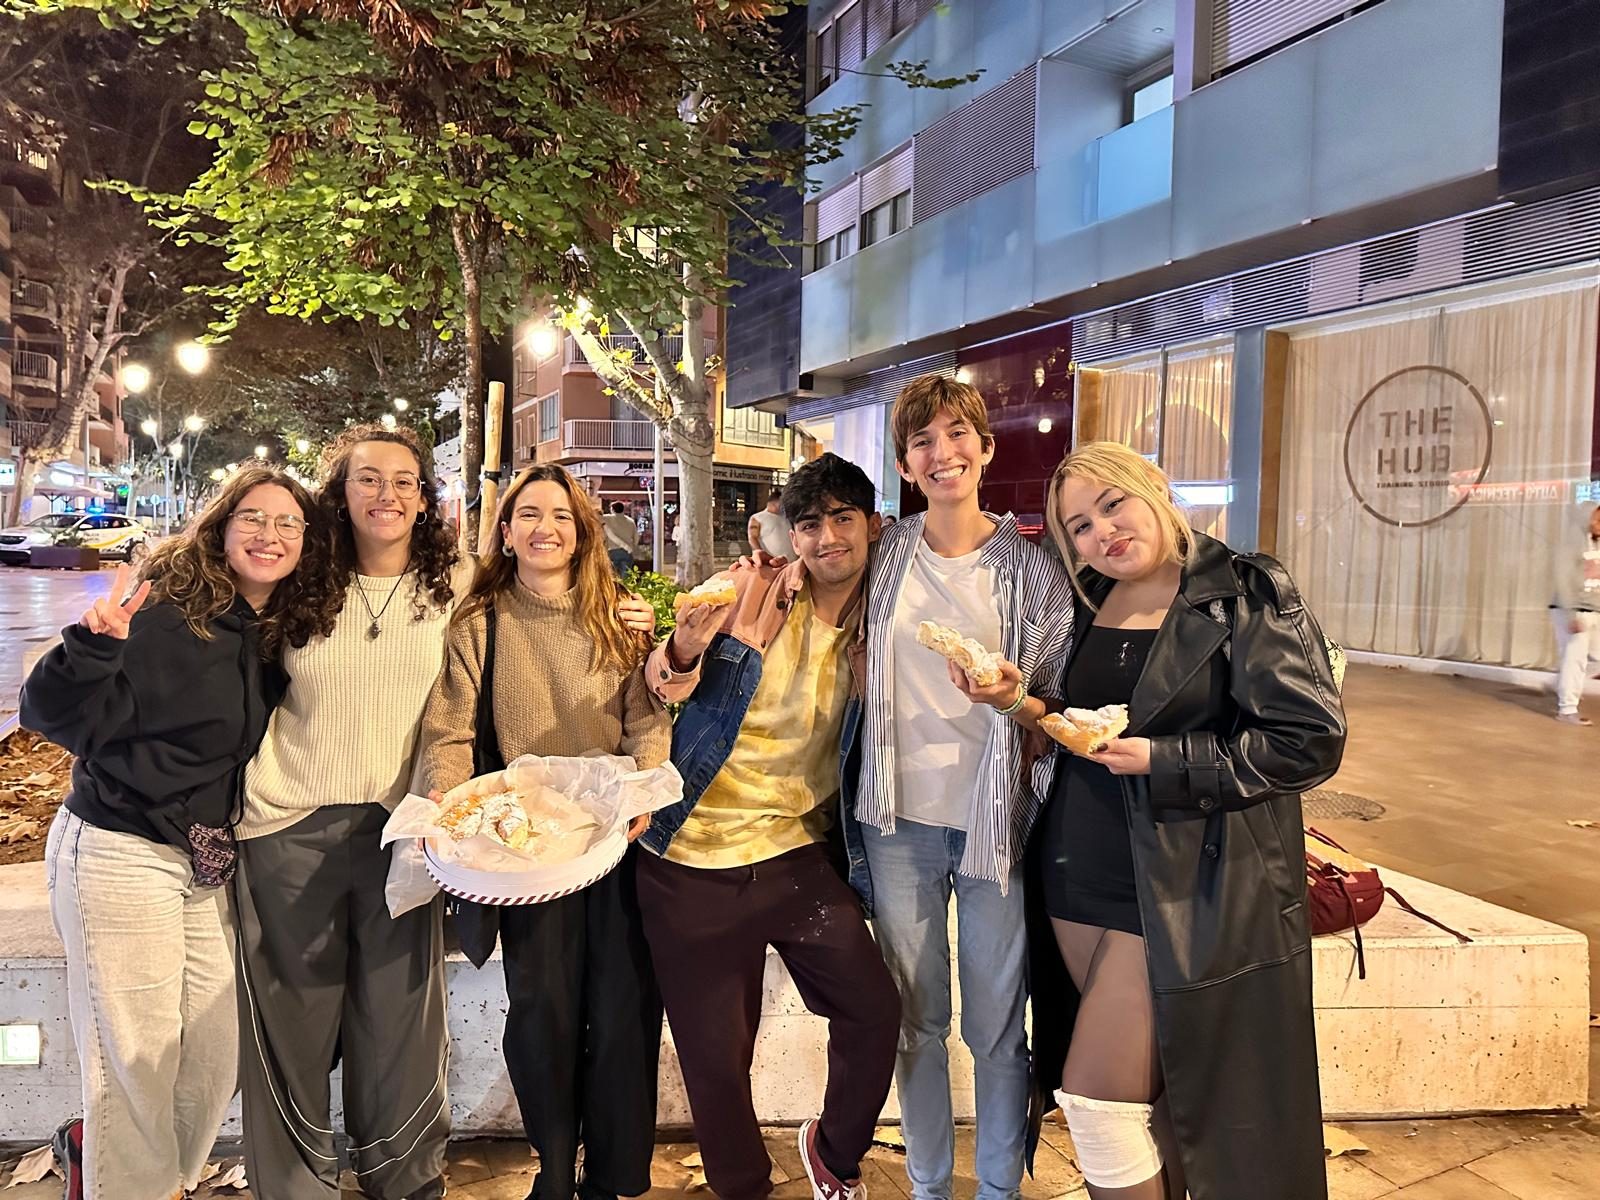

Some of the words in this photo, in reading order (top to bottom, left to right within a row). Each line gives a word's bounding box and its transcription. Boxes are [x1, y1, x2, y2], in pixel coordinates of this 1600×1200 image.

[1379, 406, 1452, 438] THE
[1377, 444, 1450, 475] HUB
[713, 469, 728, 477] omic
[1418, 480, 1450, 488] STUDIO
